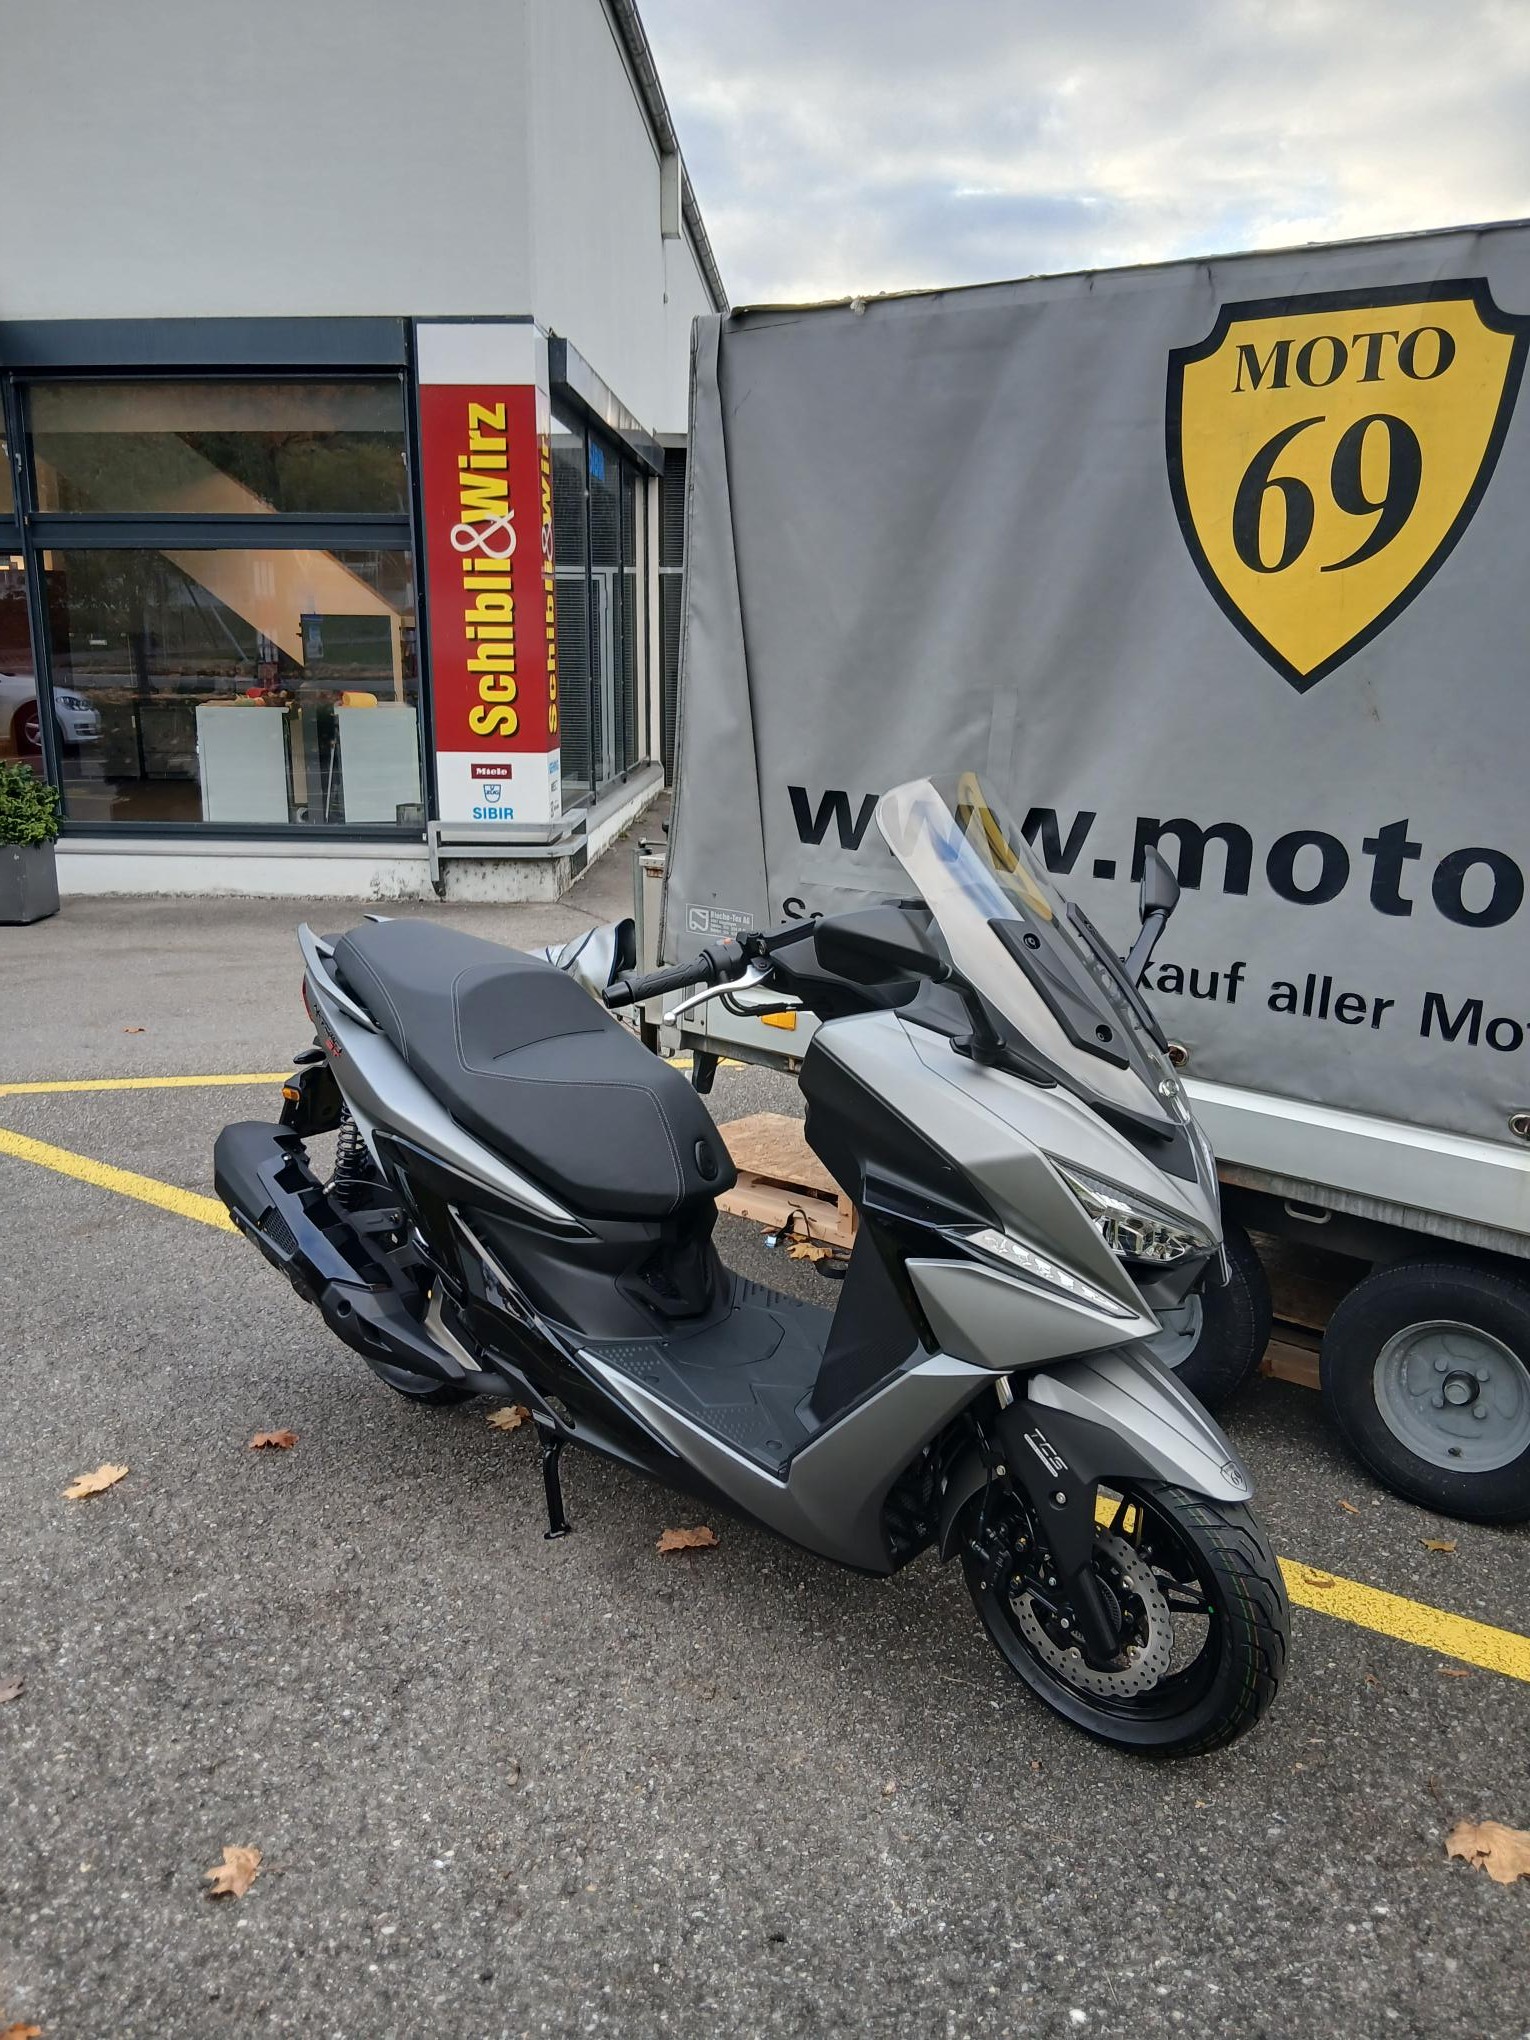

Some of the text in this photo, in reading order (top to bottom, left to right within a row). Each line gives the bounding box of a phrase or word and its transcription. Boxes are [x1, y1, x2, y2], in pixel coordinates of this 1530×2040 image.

[1231, 327, 1456, 393] MOTO
[1232, 413, 1422, 574] 69
[473, 807, 514, 820] SIBIR
[1267, 973, 1395, 1030] aller
[1420, 992, 1530, 1052] Mo
